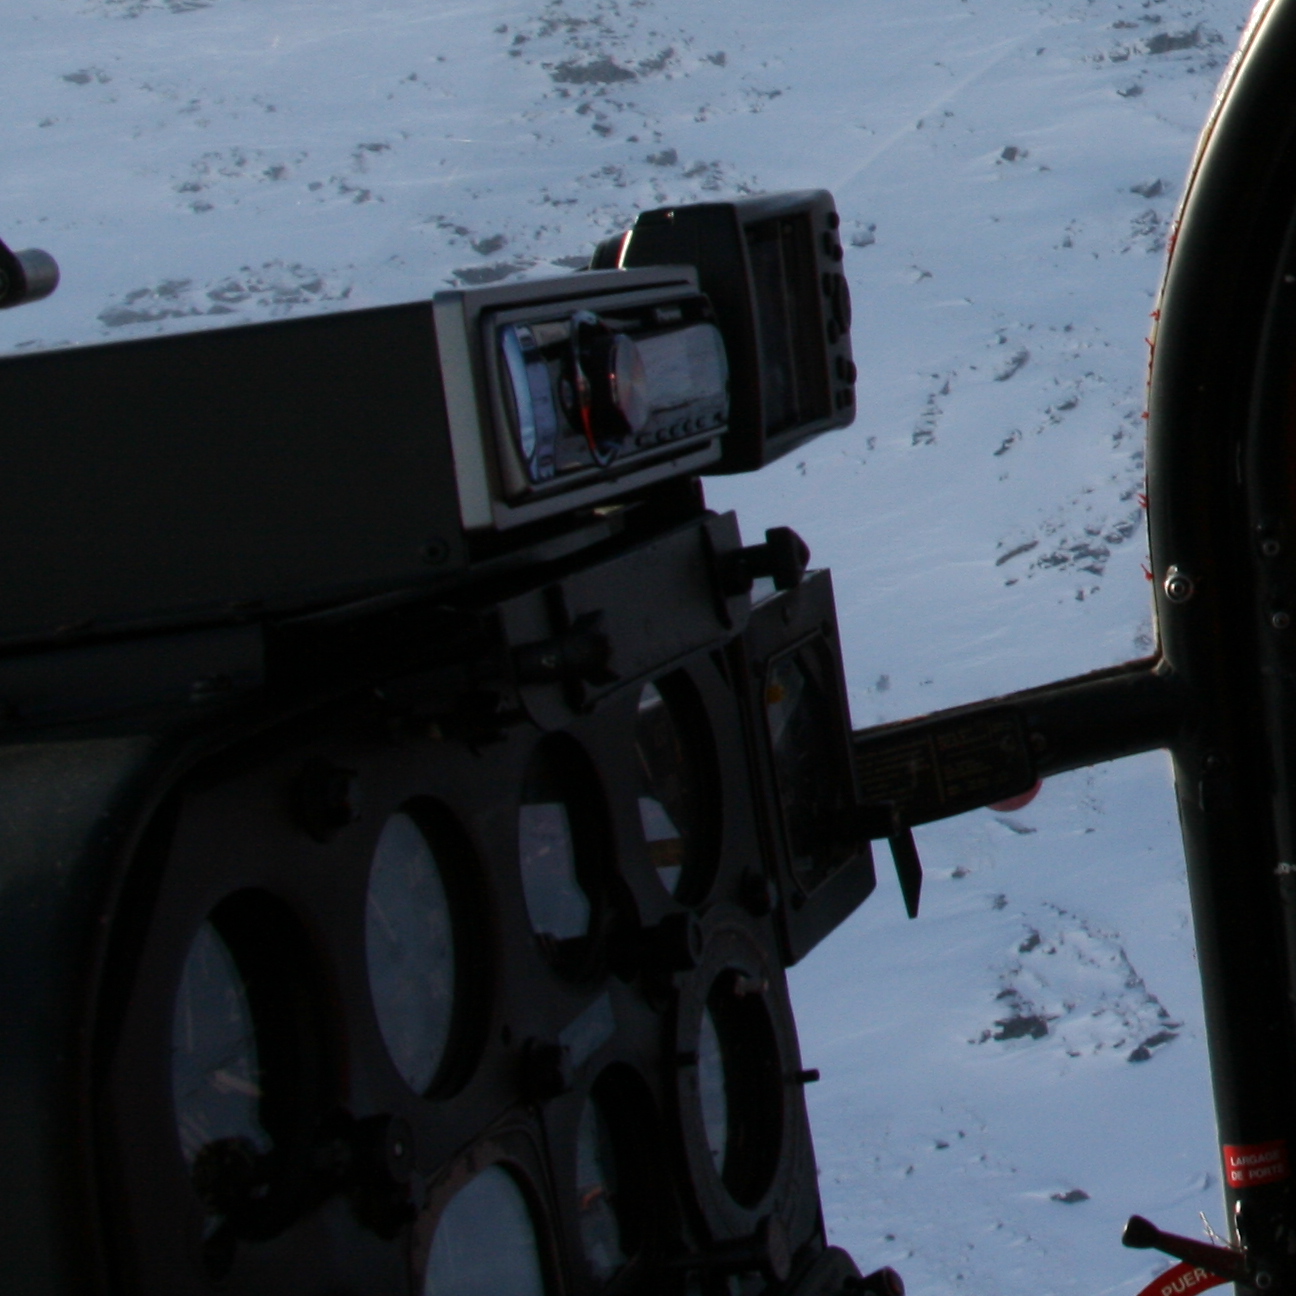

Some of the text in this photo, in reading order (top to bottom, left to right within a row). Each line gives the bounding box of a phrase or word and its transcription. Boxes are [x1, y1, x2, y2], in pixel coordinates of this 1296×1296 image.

[1230, 1148, 1280, 1166] LARGAGE
[1231, 1161, 1284, 1182] DE PORTE
[1160, 1267, 1213, 1296] PUER
